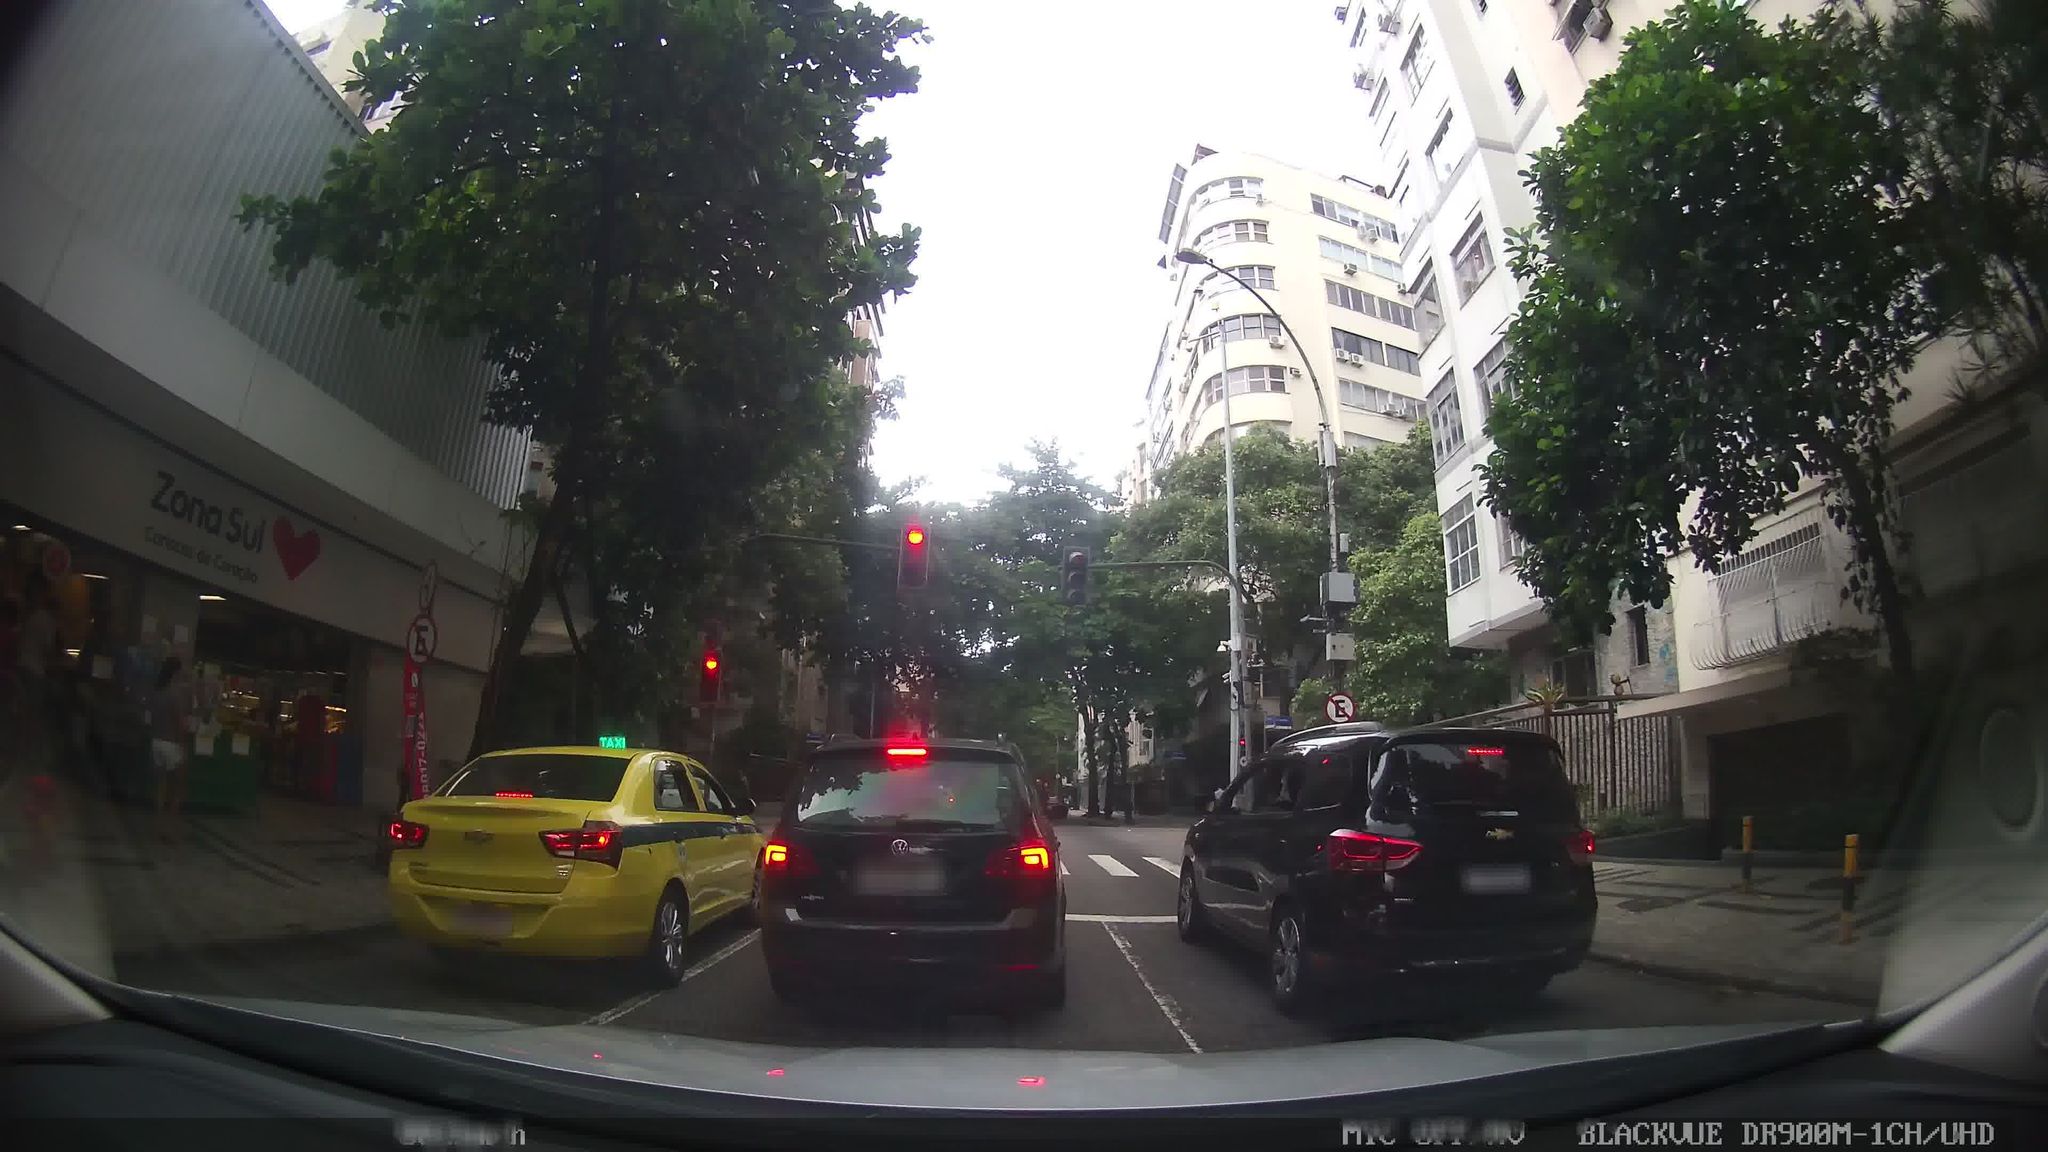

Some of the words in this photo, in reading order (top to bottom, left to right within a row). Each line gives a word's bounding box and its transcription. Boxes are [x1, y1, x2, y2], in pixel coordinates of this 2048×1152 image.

[151, 471, 223, 535] Zona
[225, 507, 266, 553] Sul
[1334, 699, 1347, 718] E
[599, 737, 626, 750] TAXI
